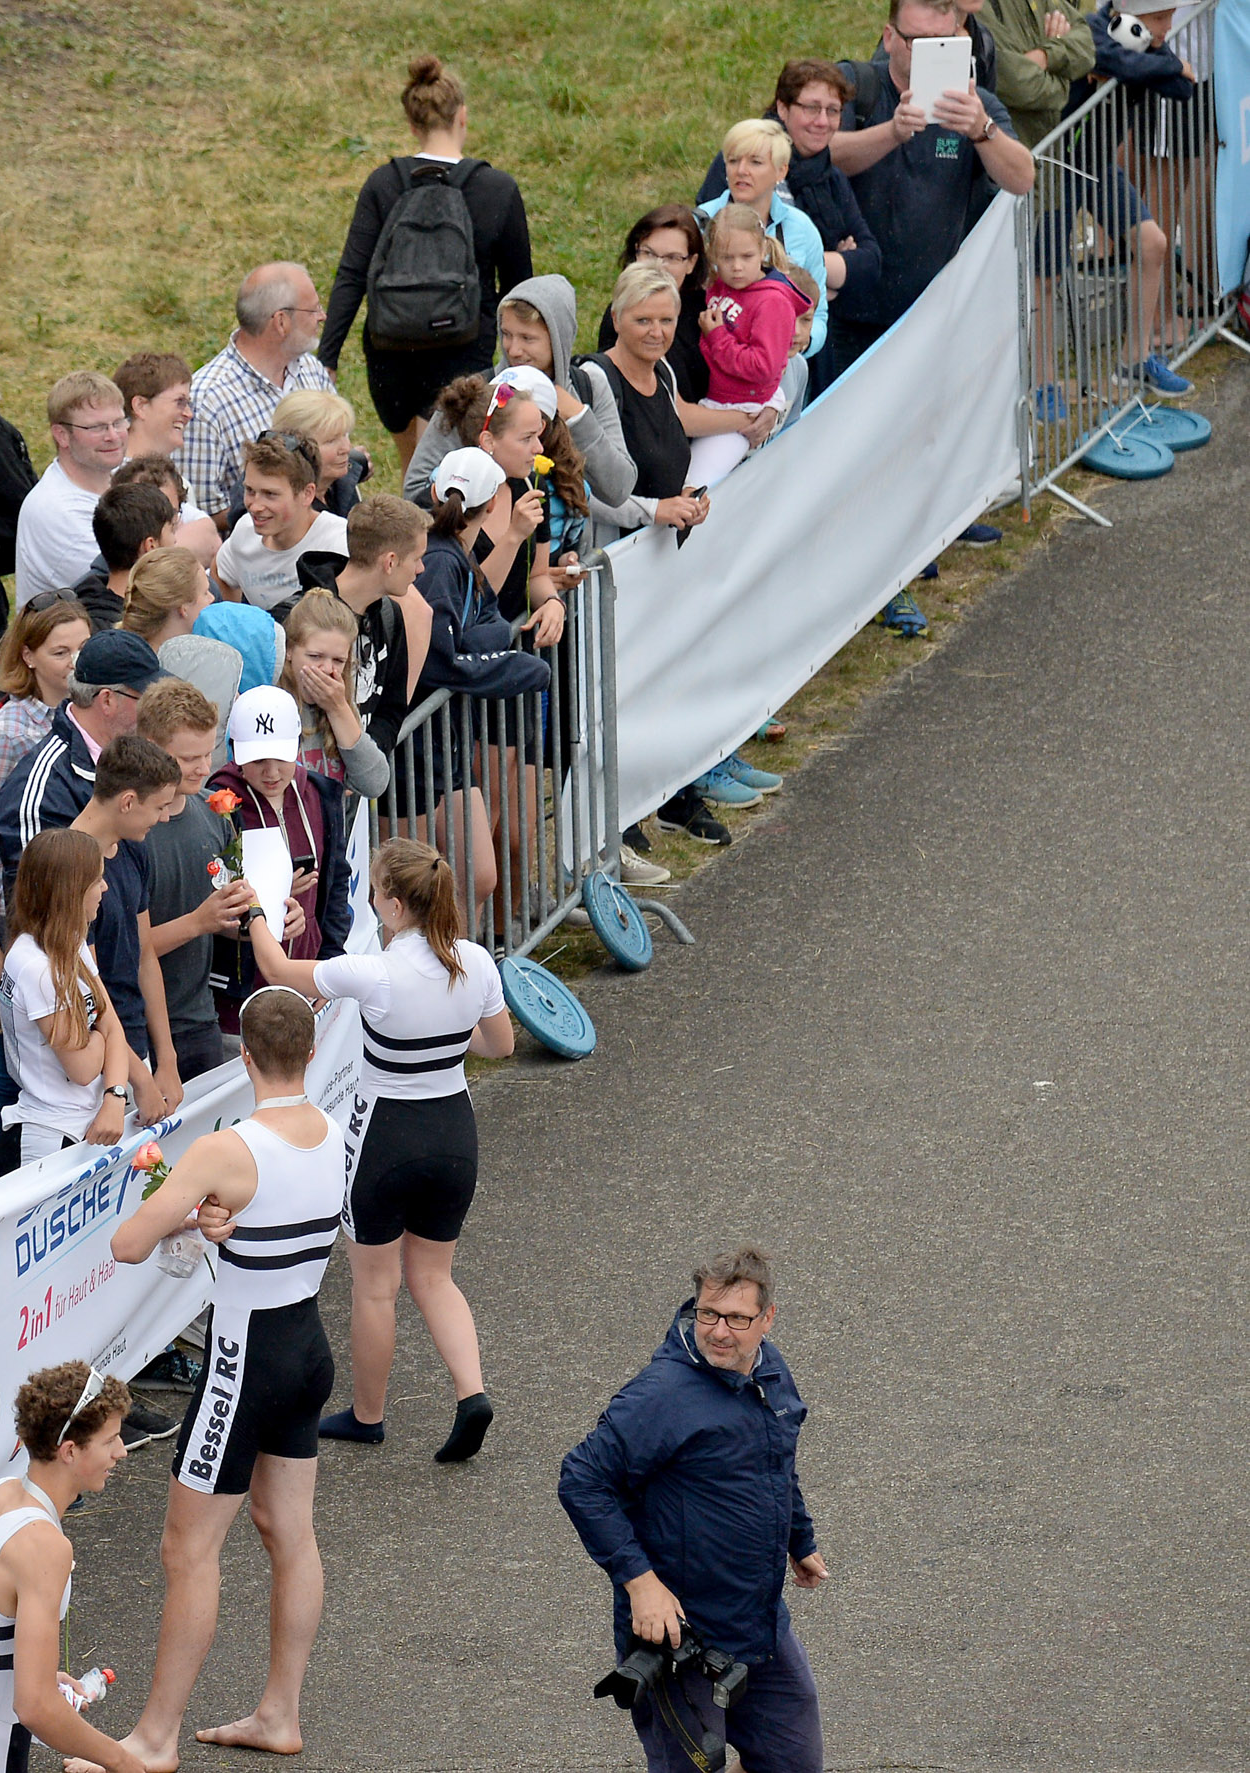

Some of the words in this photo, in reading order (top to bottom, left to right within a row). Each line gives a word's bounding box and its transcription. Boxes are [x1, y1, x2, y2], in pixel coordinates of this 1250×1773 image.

[255, 713, 274, 735] NY
[349, 1093, 368, 1137] RC
[15, 1171, 113, 1277] DUSCHE
[54, 1295, 67, 1322] für
[68, 1279, 89, 1310] Haut
[89, 1268, 97, 1293] &
[188, 1386, 235, 1482] Bessel
[215, 1336, 240, 1382] RC
